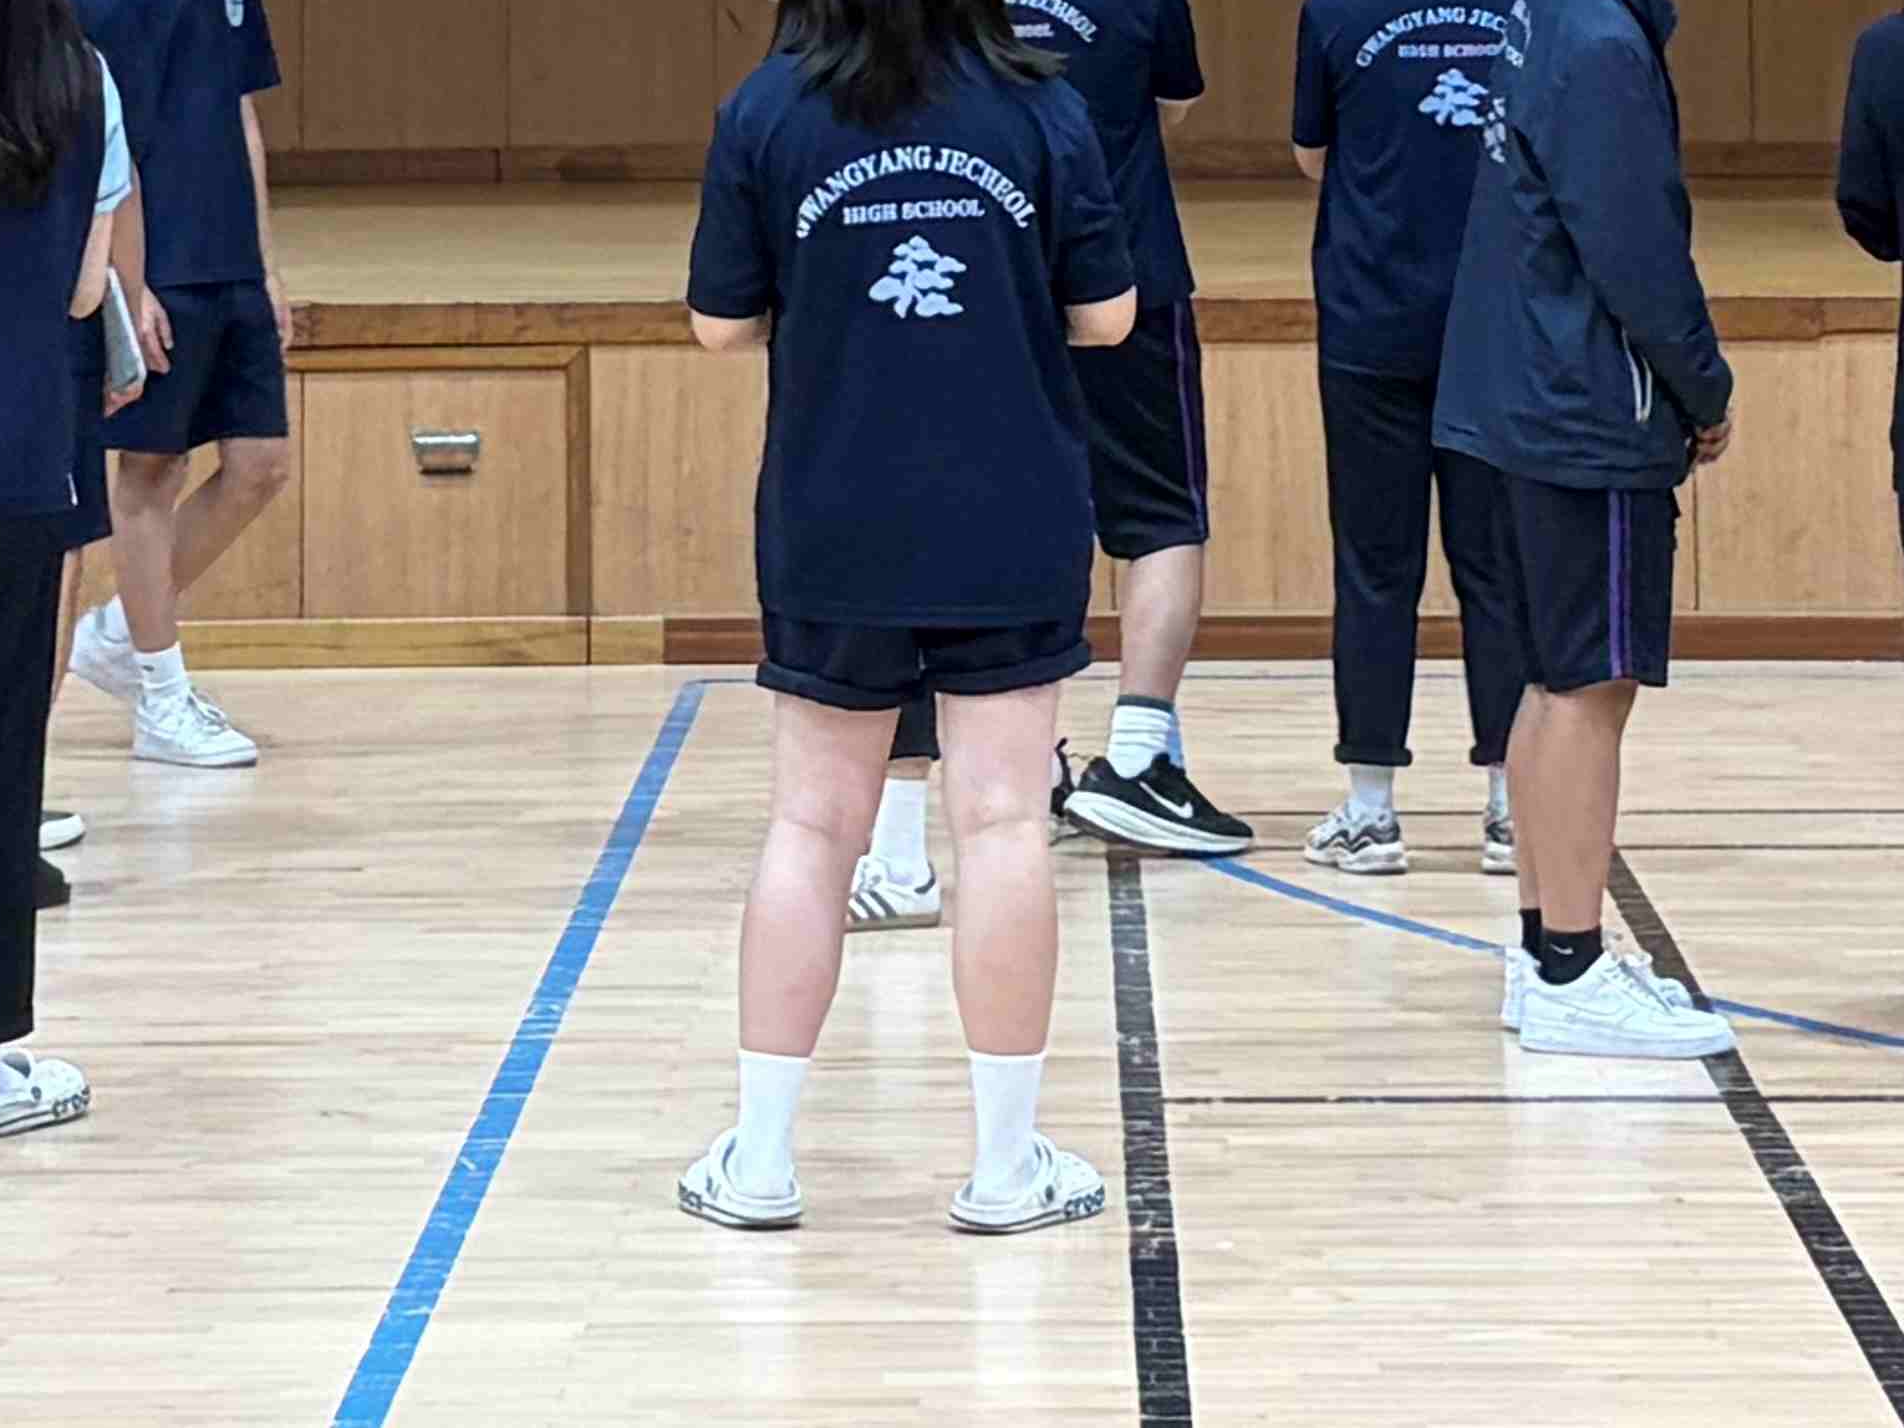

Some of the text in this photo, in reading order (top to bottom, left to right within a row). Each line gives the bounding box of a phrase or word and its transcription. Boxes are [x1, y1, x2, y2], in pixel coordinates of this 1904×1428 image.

[1355, 5, 1467, 68] GWANGYANG
[842, 198, 986, 226] HIGH SCHOOL
[933, 147, 1039, 229] JECHEOL
